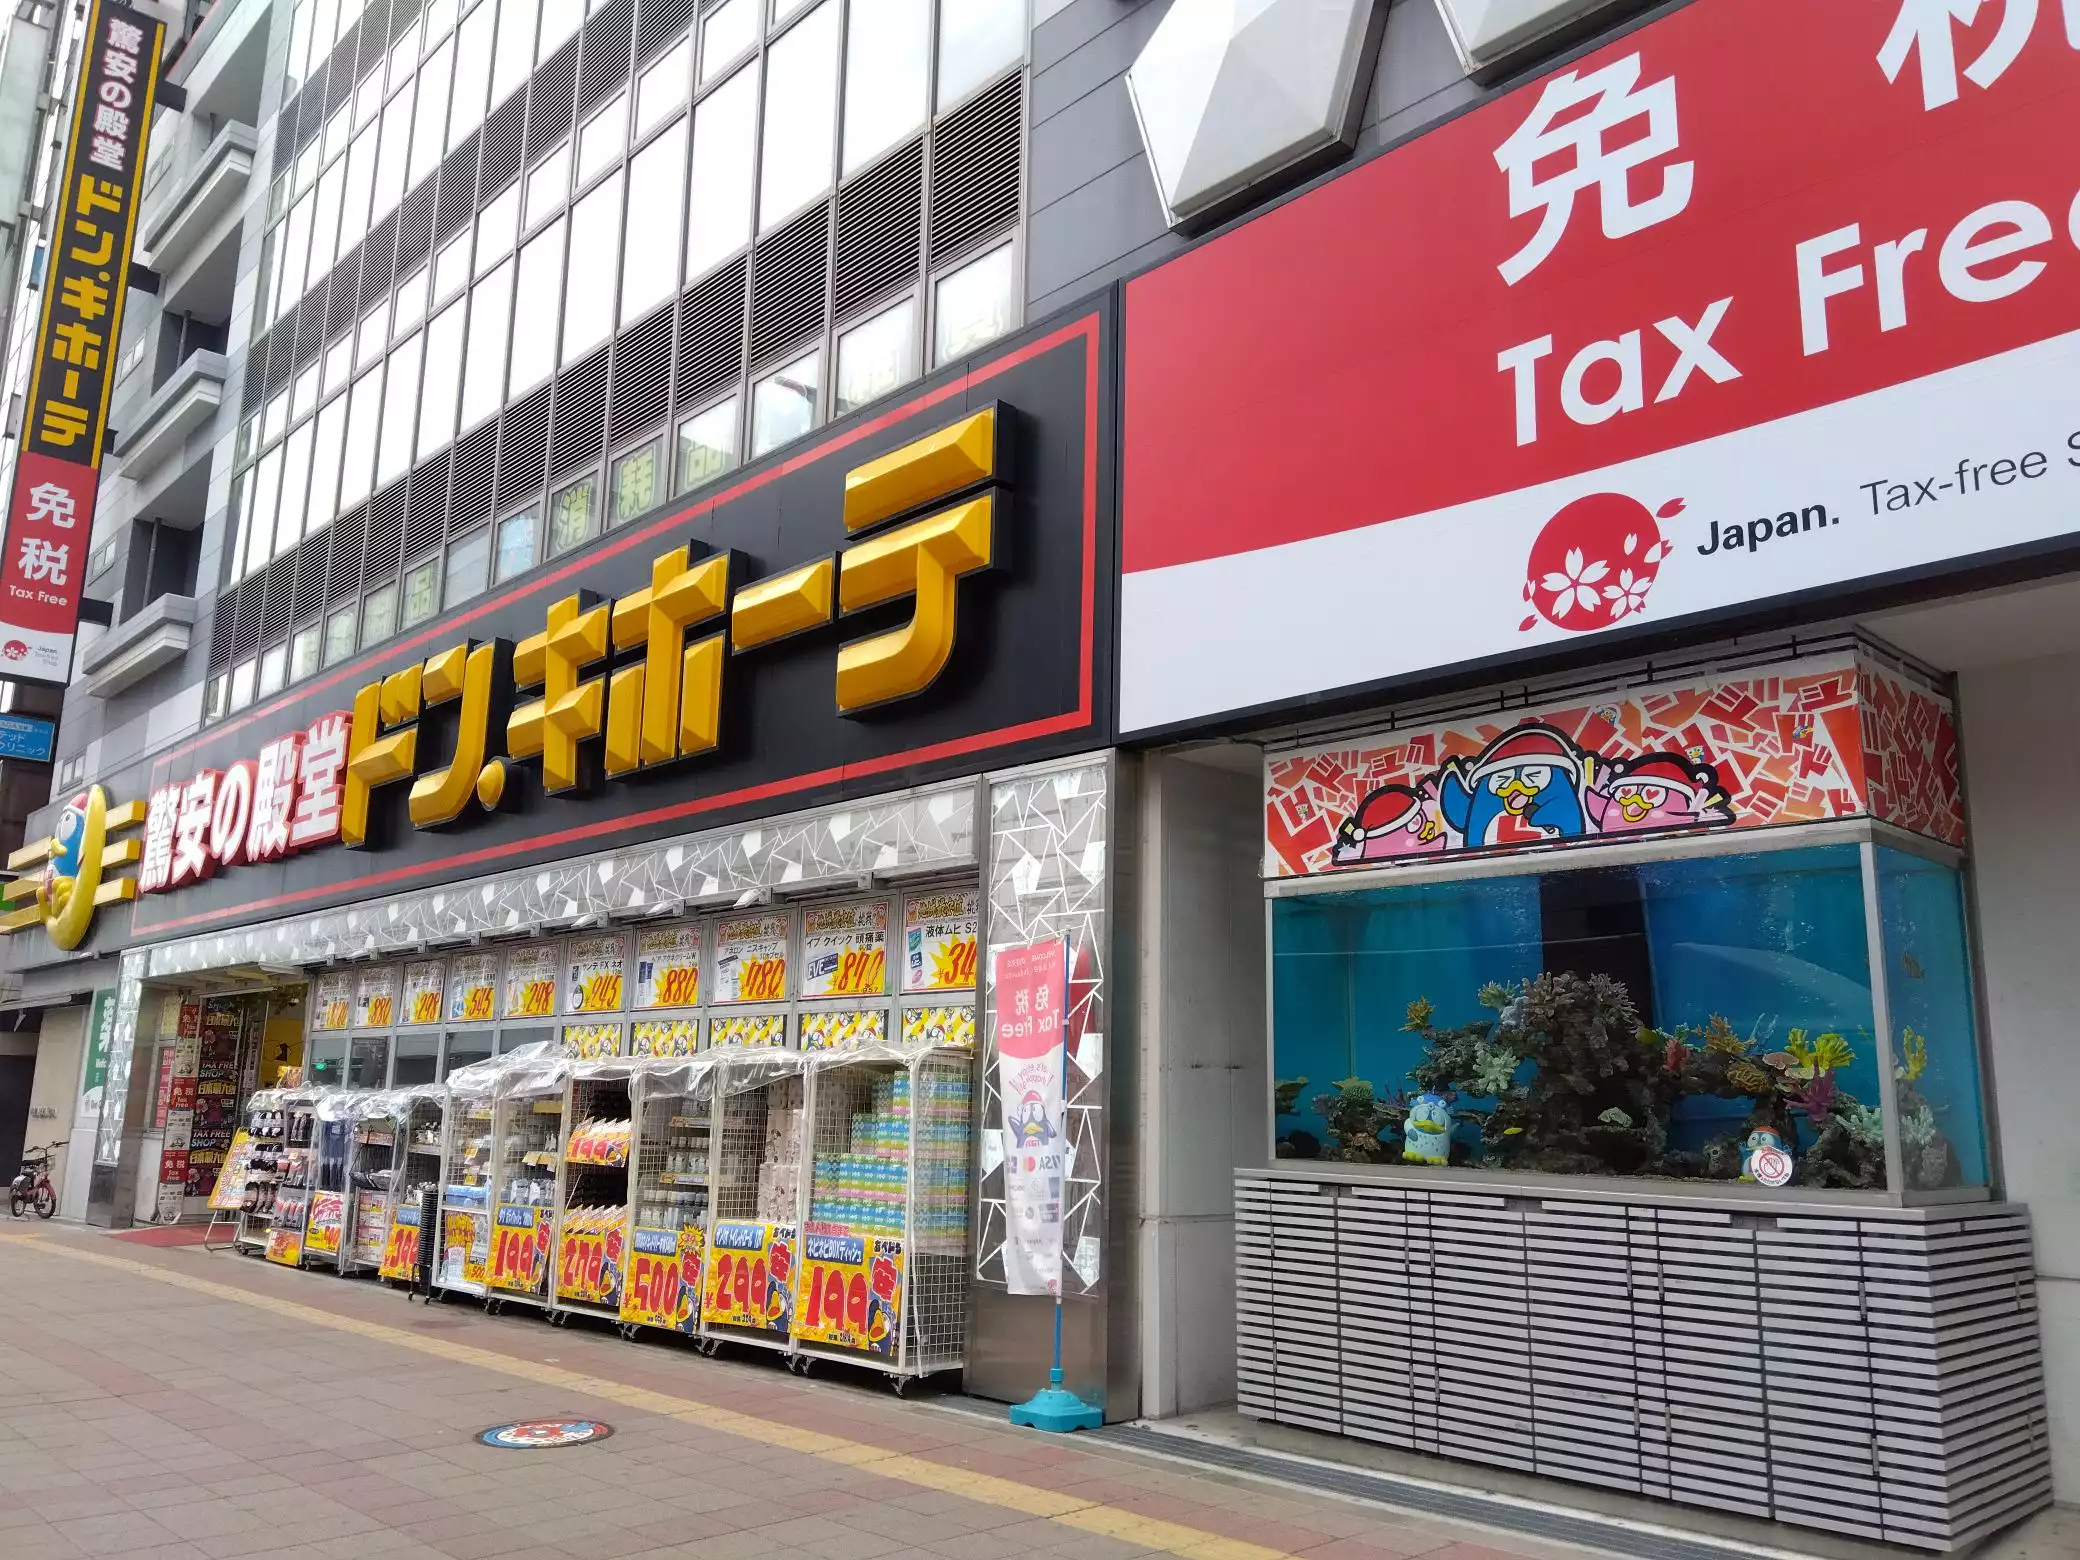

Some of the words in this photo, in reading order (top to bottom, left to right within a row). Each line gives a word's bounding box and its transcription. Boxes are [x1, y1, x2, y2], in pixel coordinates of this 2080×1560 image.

[90, 17, 143, 172] 驚安の殿堂
[1497, 295, 1742, 447] Tax
[18, 482, 76, 586] 免税
[1696, 498, 1842, 557] Japan.
[1859, 450, 2050, 518] Tax-free
[9, 584, 35, 601] Tax
[37, 590, 68, 606] Free
[138, 715, 350, 894] 驚安の殿堂
[855, 931, 885, 944] 頭痛薬
[191, 1138, 216, 1148] SHOP
[494, 1229, 535, 1282] 199
[804, 1265, 869, 1336] 199
